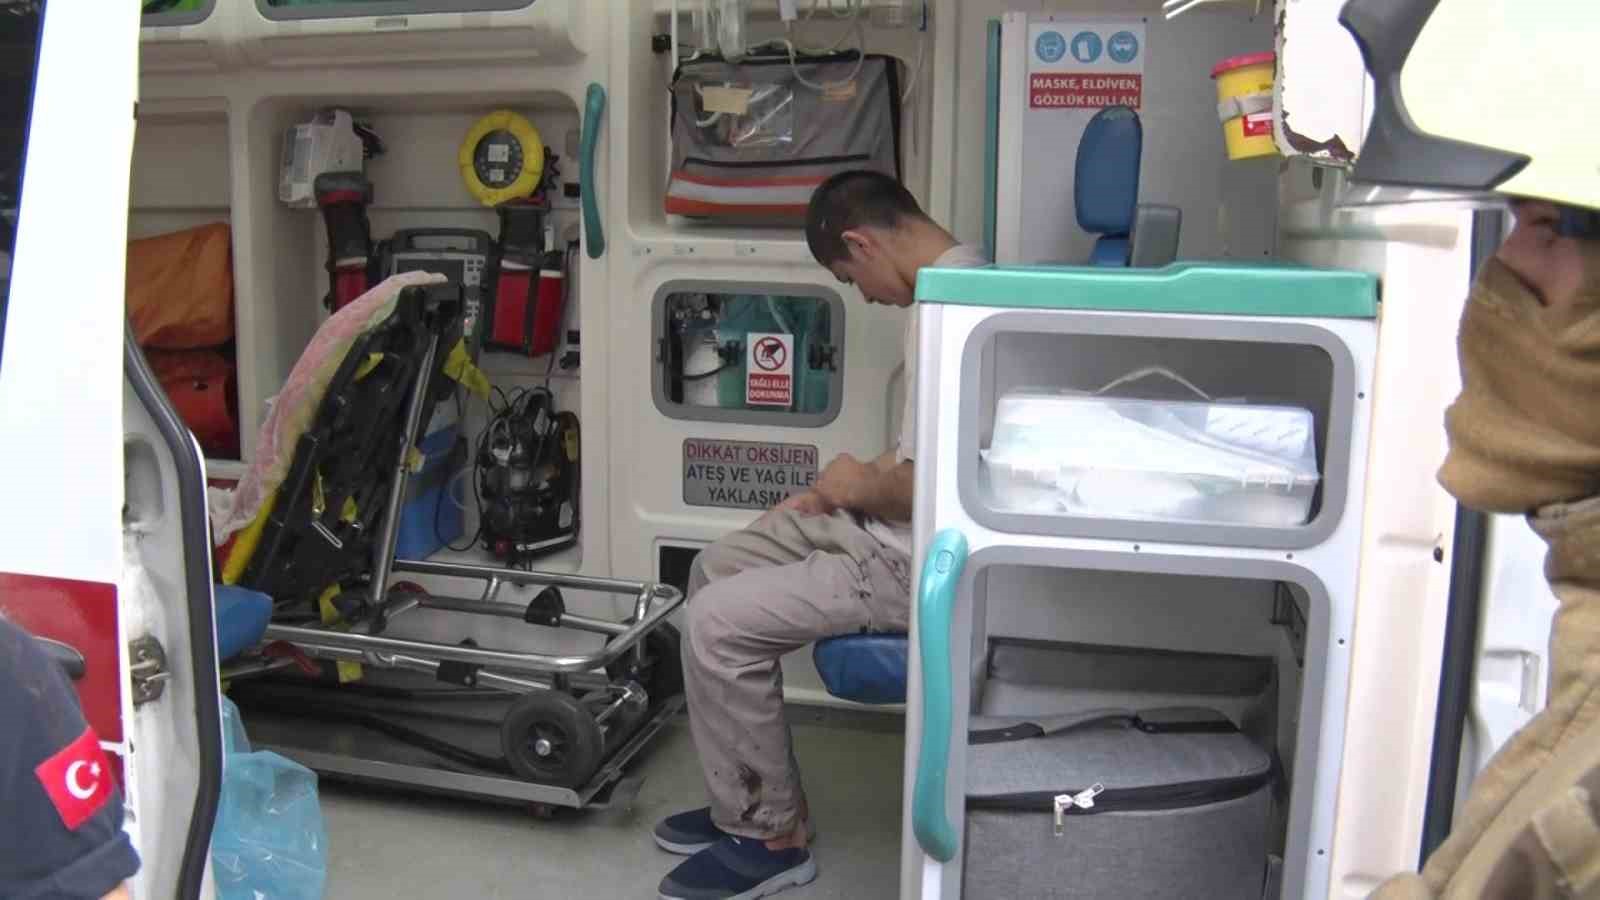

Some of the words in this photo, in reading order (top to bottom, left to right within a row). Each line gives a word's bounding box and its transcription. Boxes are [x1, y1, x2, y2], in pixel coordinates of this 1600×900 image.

[1032, 79, 1080, 90] MASKE,
[1082, 78, 1139, 91] ELDİVEN,
[1033, 93, 1085, 105] GÖZLÜK
[1087, 95, 1138, 106] KULLAN
[687, 464, 725, 484] ATEŞ
[730, 467, 750, 482] VE
